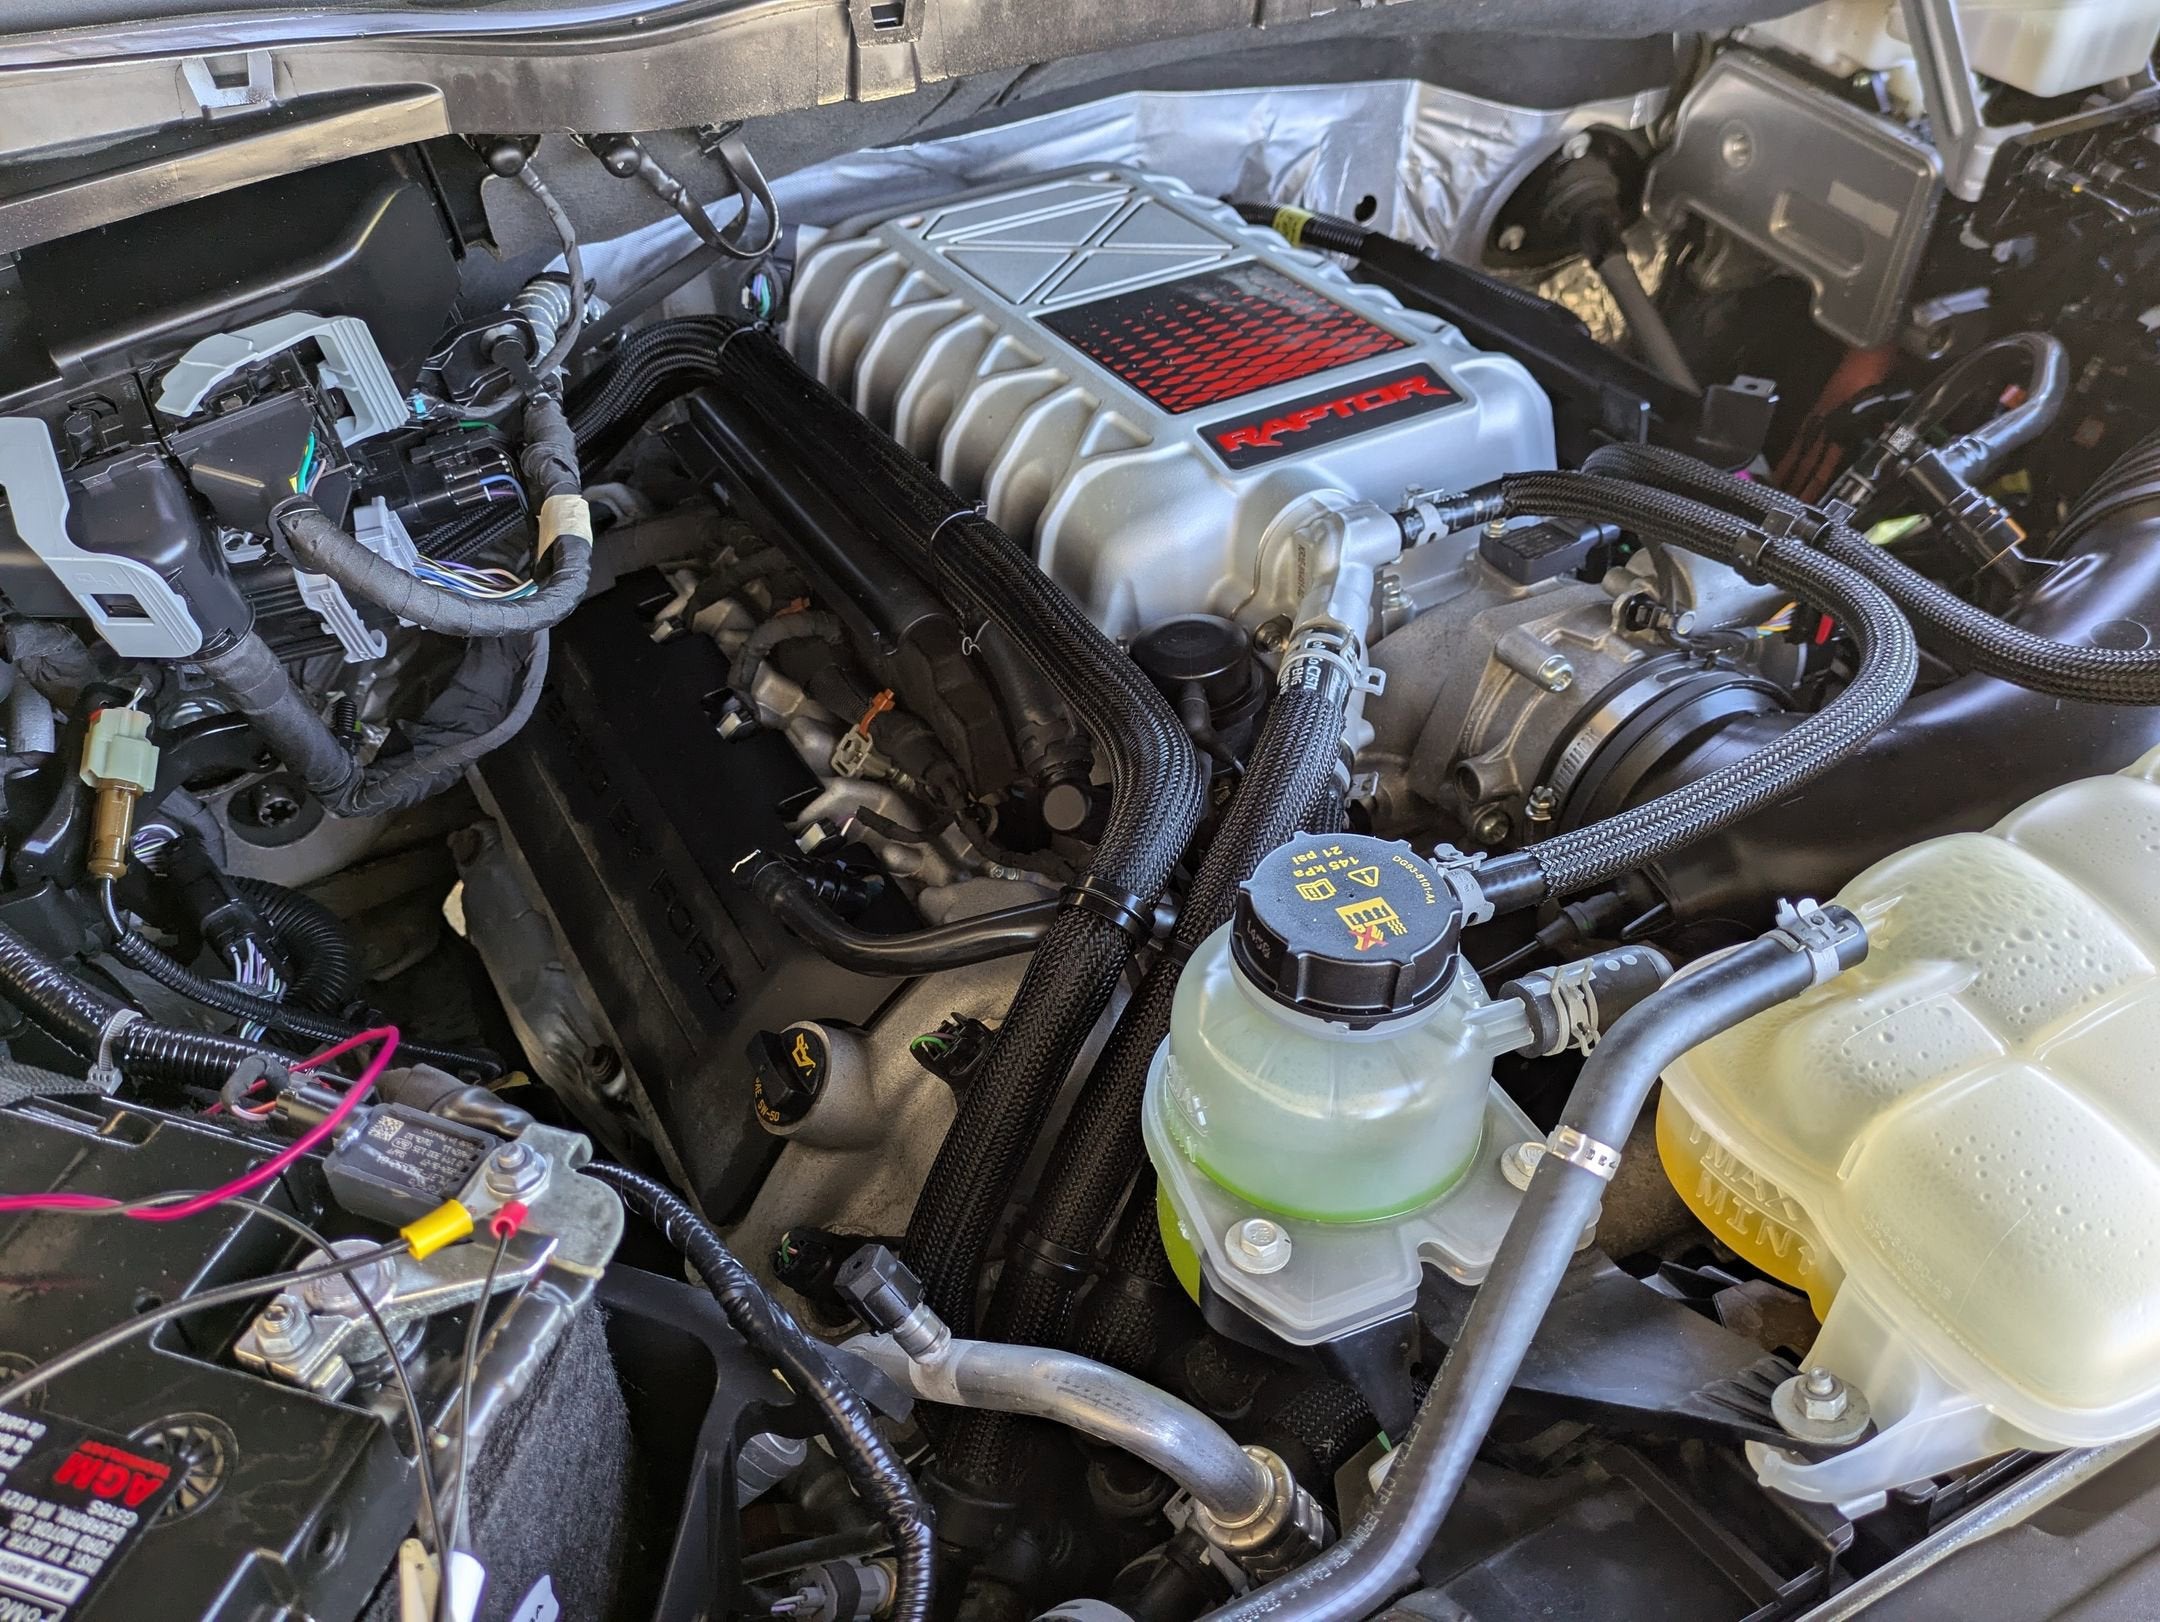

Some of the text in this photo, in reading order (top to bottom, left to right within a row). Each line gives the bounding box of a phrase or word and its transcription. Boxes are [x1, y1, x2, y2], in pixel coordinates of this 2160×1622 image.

[1218, 375, 1451, 452] RAPTOR
[1291, 845, 1344, 867] 21 psi
[1292, 856, 1360, 879] 145 kPa
[648, 867, 739, 1012] FORD
[757, 1099, 781, 1122] 5W-50
[1694, 1168, 1794, 1259] MIN
[53, 1451, 165, 1508] AGM
[29, 1518, 81, 1548] MOTOR
[74, 1533, 116, 1561] FORD
